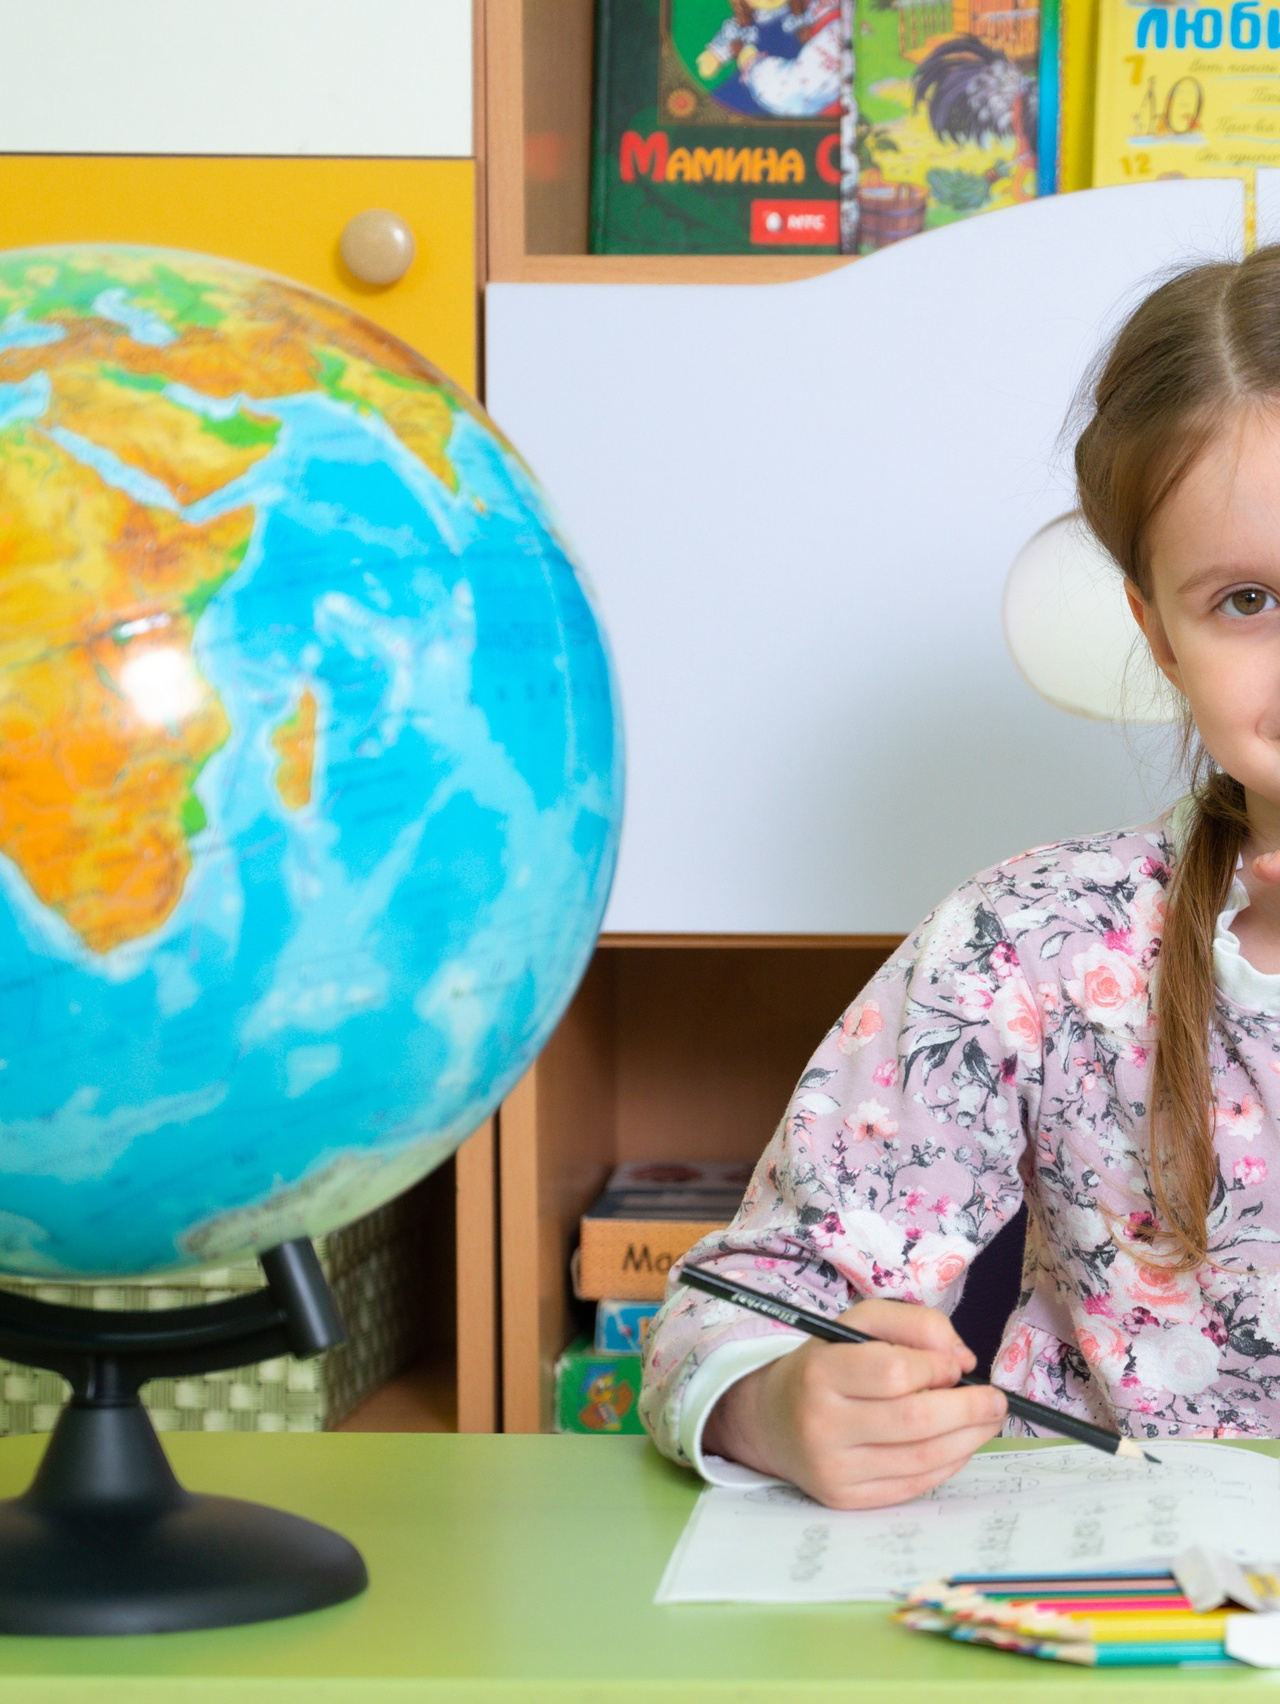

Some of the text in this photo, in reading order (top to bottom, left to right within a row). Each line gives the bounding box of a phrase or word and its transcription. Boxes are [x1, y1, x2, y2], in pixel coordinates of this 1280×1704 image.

[1124, 54, 1146, 85] 7
[620, 131, 805, 182] Мамина
[1120, 152, 1151, 176] 12
